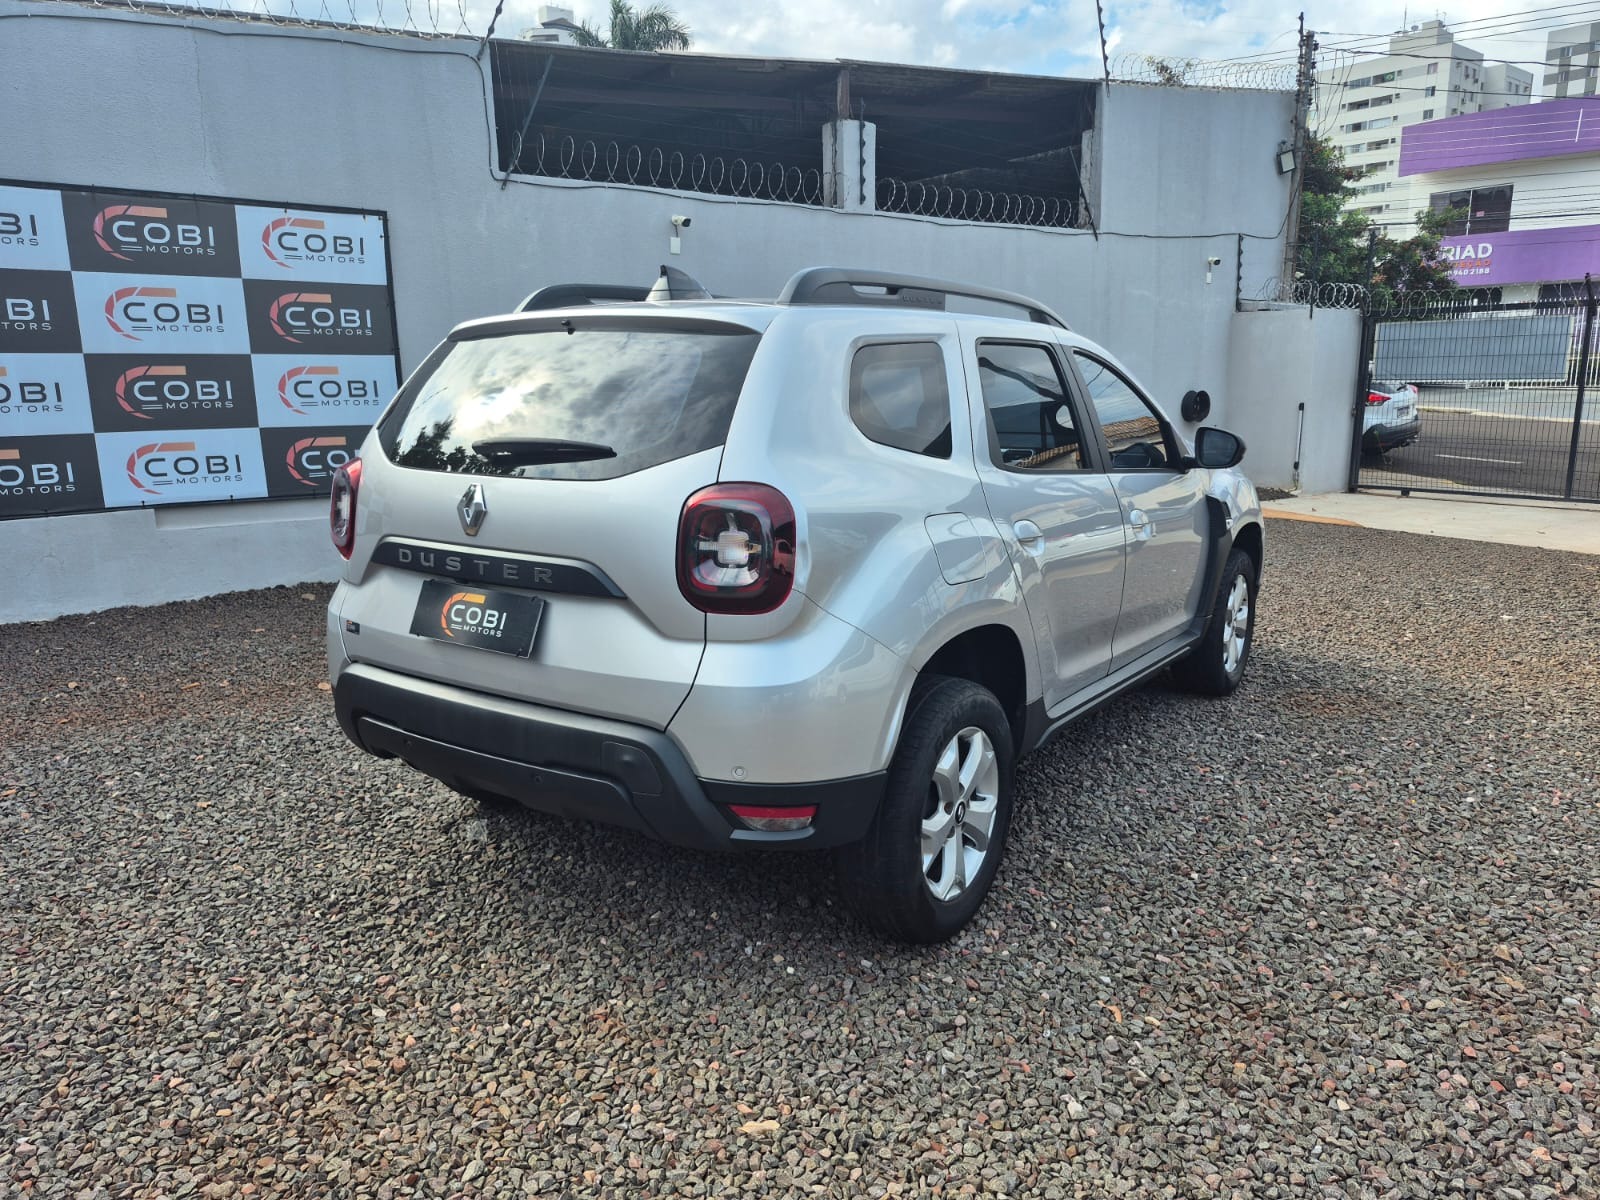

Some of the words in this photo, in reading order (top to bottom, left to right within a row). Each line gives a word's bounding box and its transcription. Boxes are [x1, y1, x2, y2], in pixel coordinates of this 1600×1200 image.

[112, 220, 215, 247] COBI
[145, 244, 216, 256] MOTORS
[277, 231, 365, 256] COBI
[305, 254, 366, 264] MOTORS
[123, 302, 224, 324] COBI
[285, 306, 373, 329] COBI
[156, 324, 225, 333] MOTORS
[313, 328, 373, 336] MOTORS
[133, 380, 233, 401] COBI
[293, 379, 379, 399] COBI
[166, 400, 234, 409] MOTORS
[321, 399, 380, 407] MOTORS
[144, 454, 242, 478] COBI
[176, 474, 243, 485] MOTORS
[0, 483, 76, 496] MOTORS
[399, 548, 553, 585] DUSTER
[450, 603, 507, 631] COBI
[463, 624, 503, 638] MOTORS
